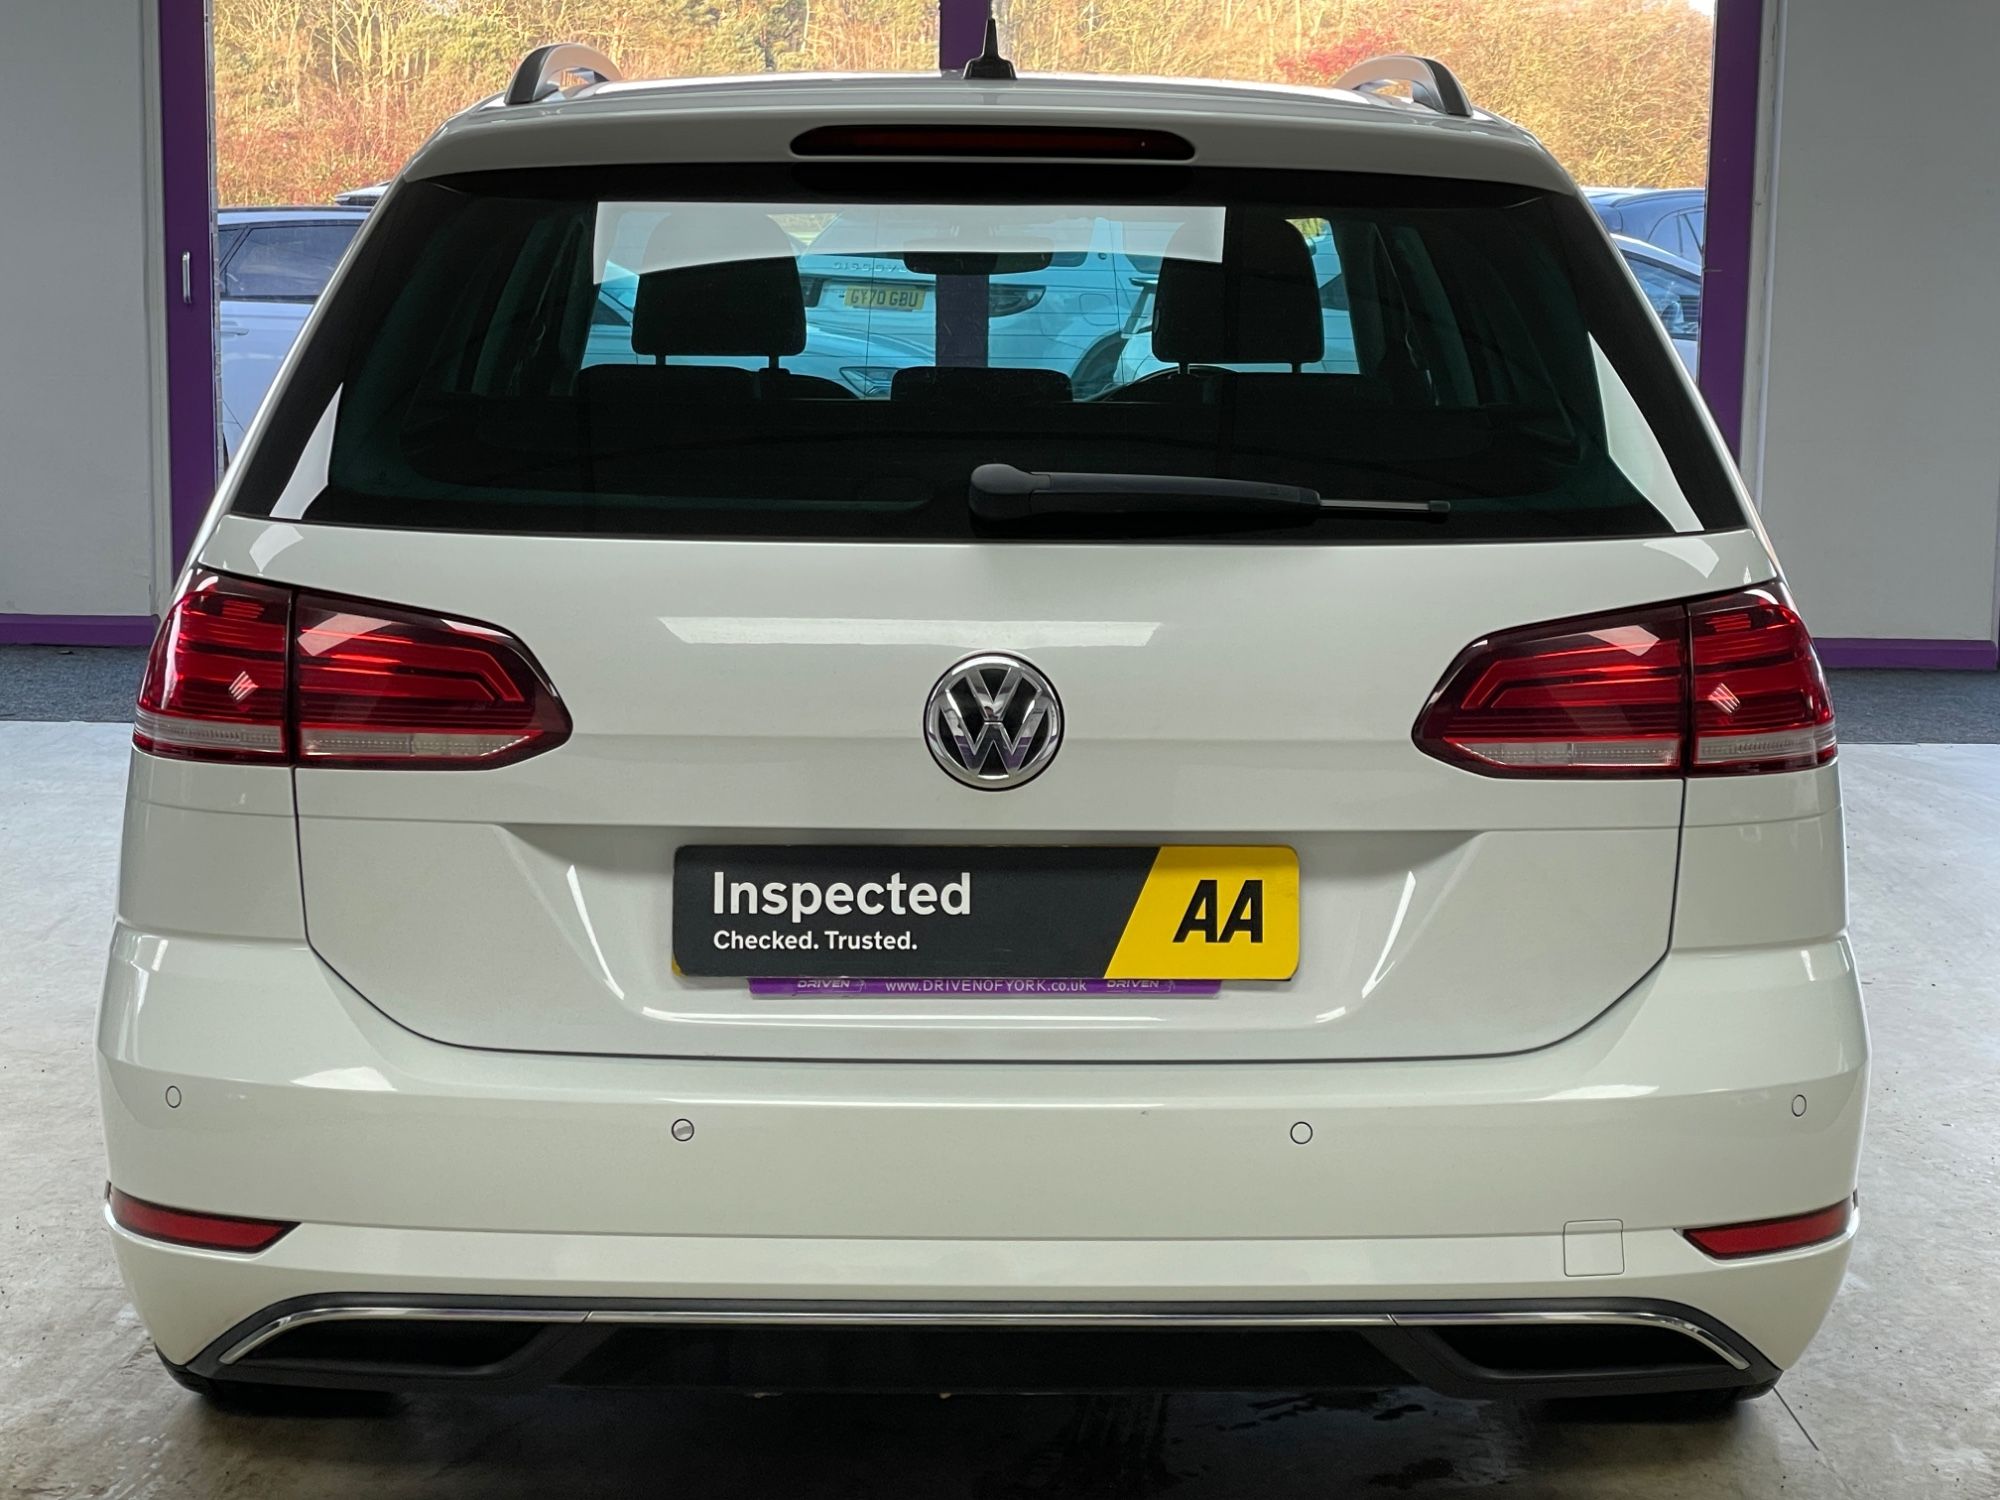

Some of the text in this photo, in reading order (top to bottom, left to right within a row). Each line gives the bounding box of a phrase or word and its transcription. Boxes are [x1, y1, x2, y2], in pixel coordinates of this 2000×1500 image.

[850, 288, 919, 308] GY70 GBU
[714, 872, 970, 923] Inspected
[1172, 880, 1263, 943] AA
[713, 930, 918, 950] Checked. Trusted.
[797, 980, 850, 988] DRIVEN
[885, 979, 1087, 992] www.DRIVENOFYORK.co.uk
[1107, 980, 1159, 988] DRIVEN
